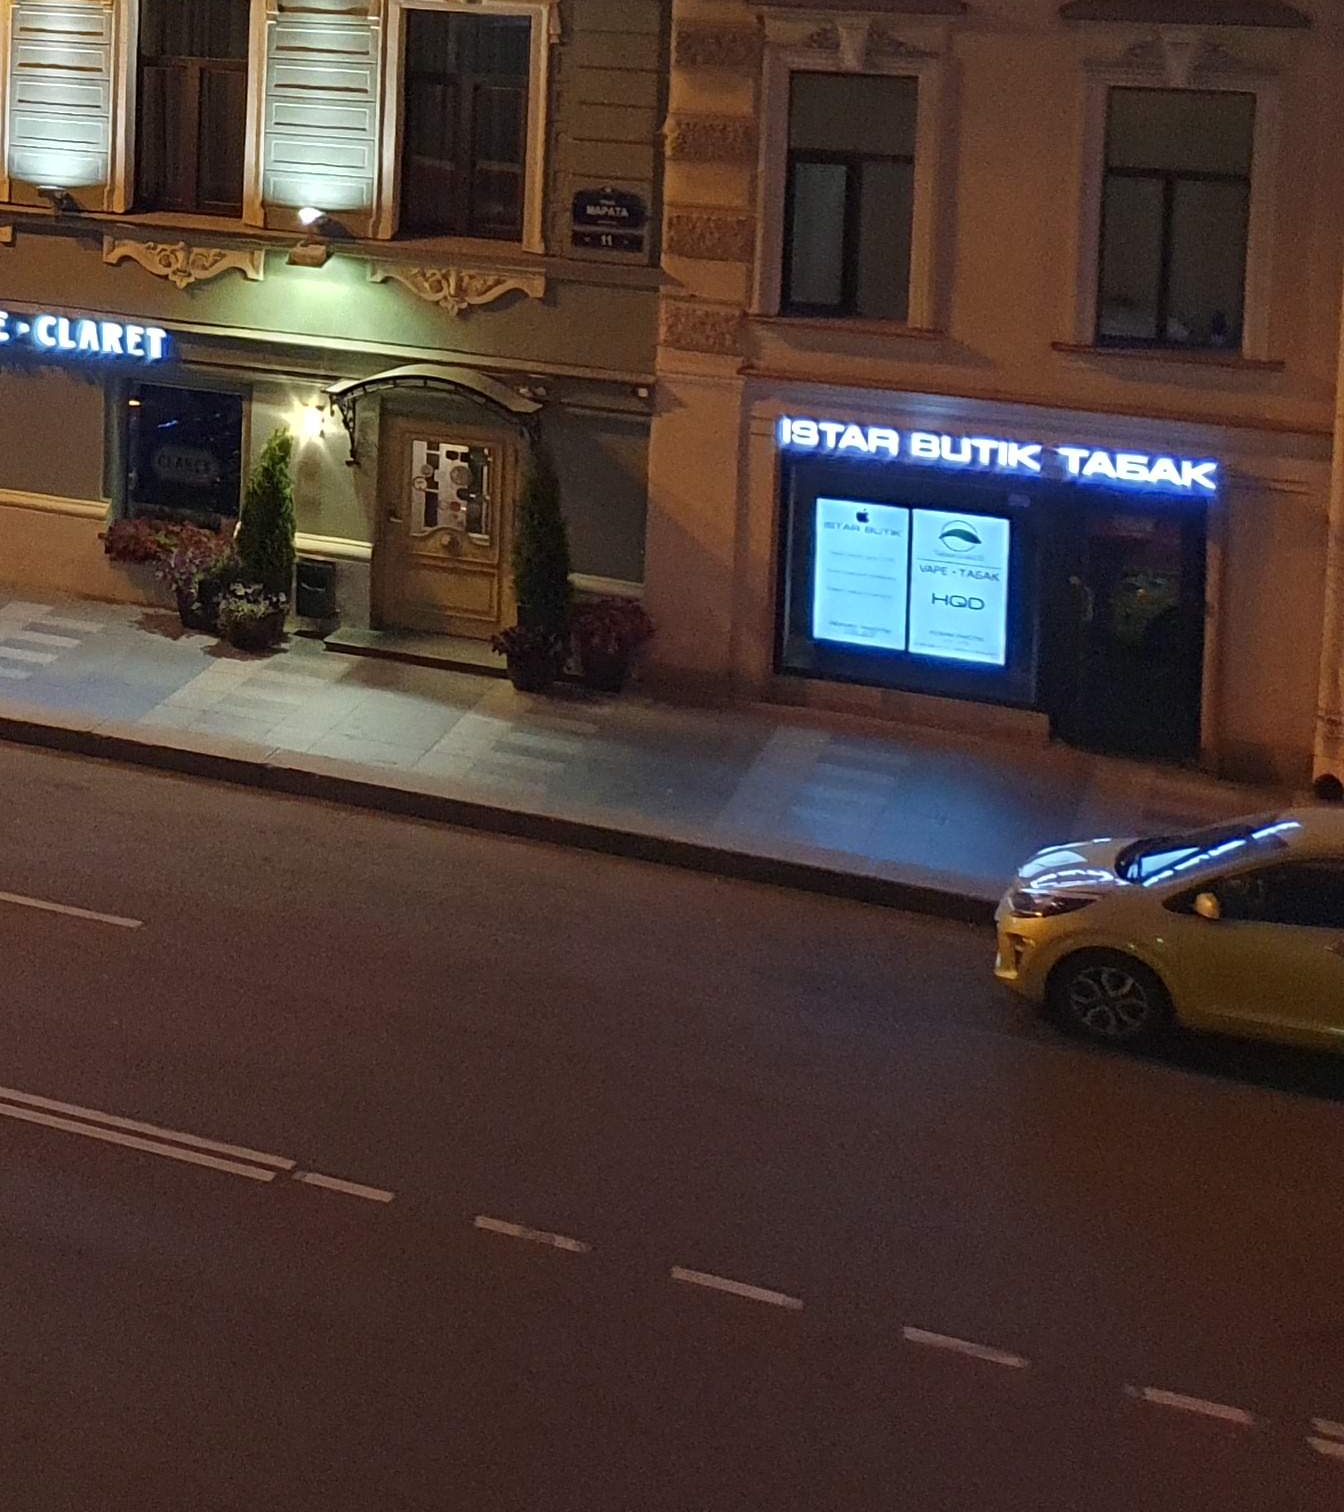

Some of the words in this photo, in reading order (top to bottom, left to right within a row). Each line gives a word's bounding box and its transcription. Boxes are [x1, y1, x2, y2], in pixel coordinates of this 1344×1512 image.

[585, 205, 630, 218] МАРАТА
[600, 234, 613, 247] 11
[35, 314, 168, 359] CLARET
[781, 418, 900, 457] ISTAR
[911, 431, 1042, 473] BUTIK
[1057, 446, 1217, 490] ТАБАК
[919, 564, 948, 576] VAPE
[931, 593, 985, 610] HQD
